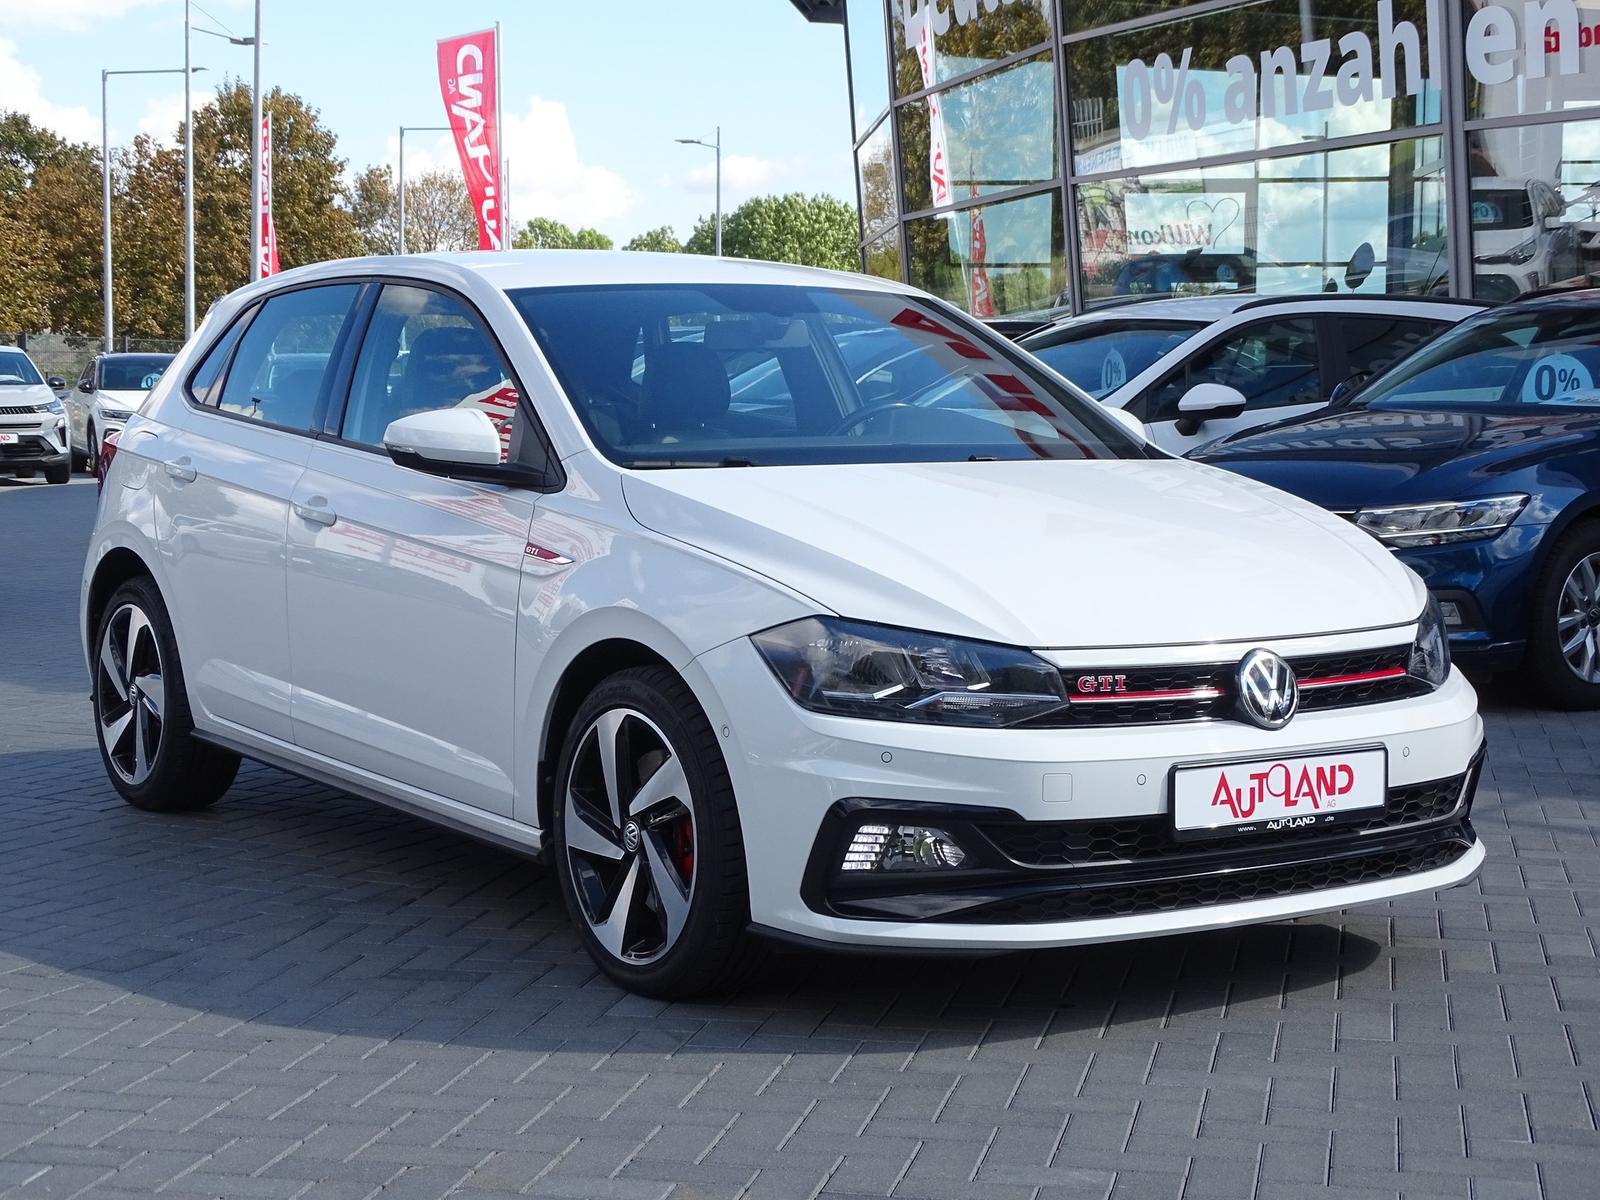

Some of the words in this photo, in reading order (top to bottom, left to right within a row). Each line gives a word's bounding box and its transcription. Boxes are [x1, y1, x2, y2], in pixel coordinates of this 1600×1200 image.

[1123, 47, 1207, 141] 0%
[1534, 364, 1581, 401] 0%
[1077, 674, 1128, 694] GTI
